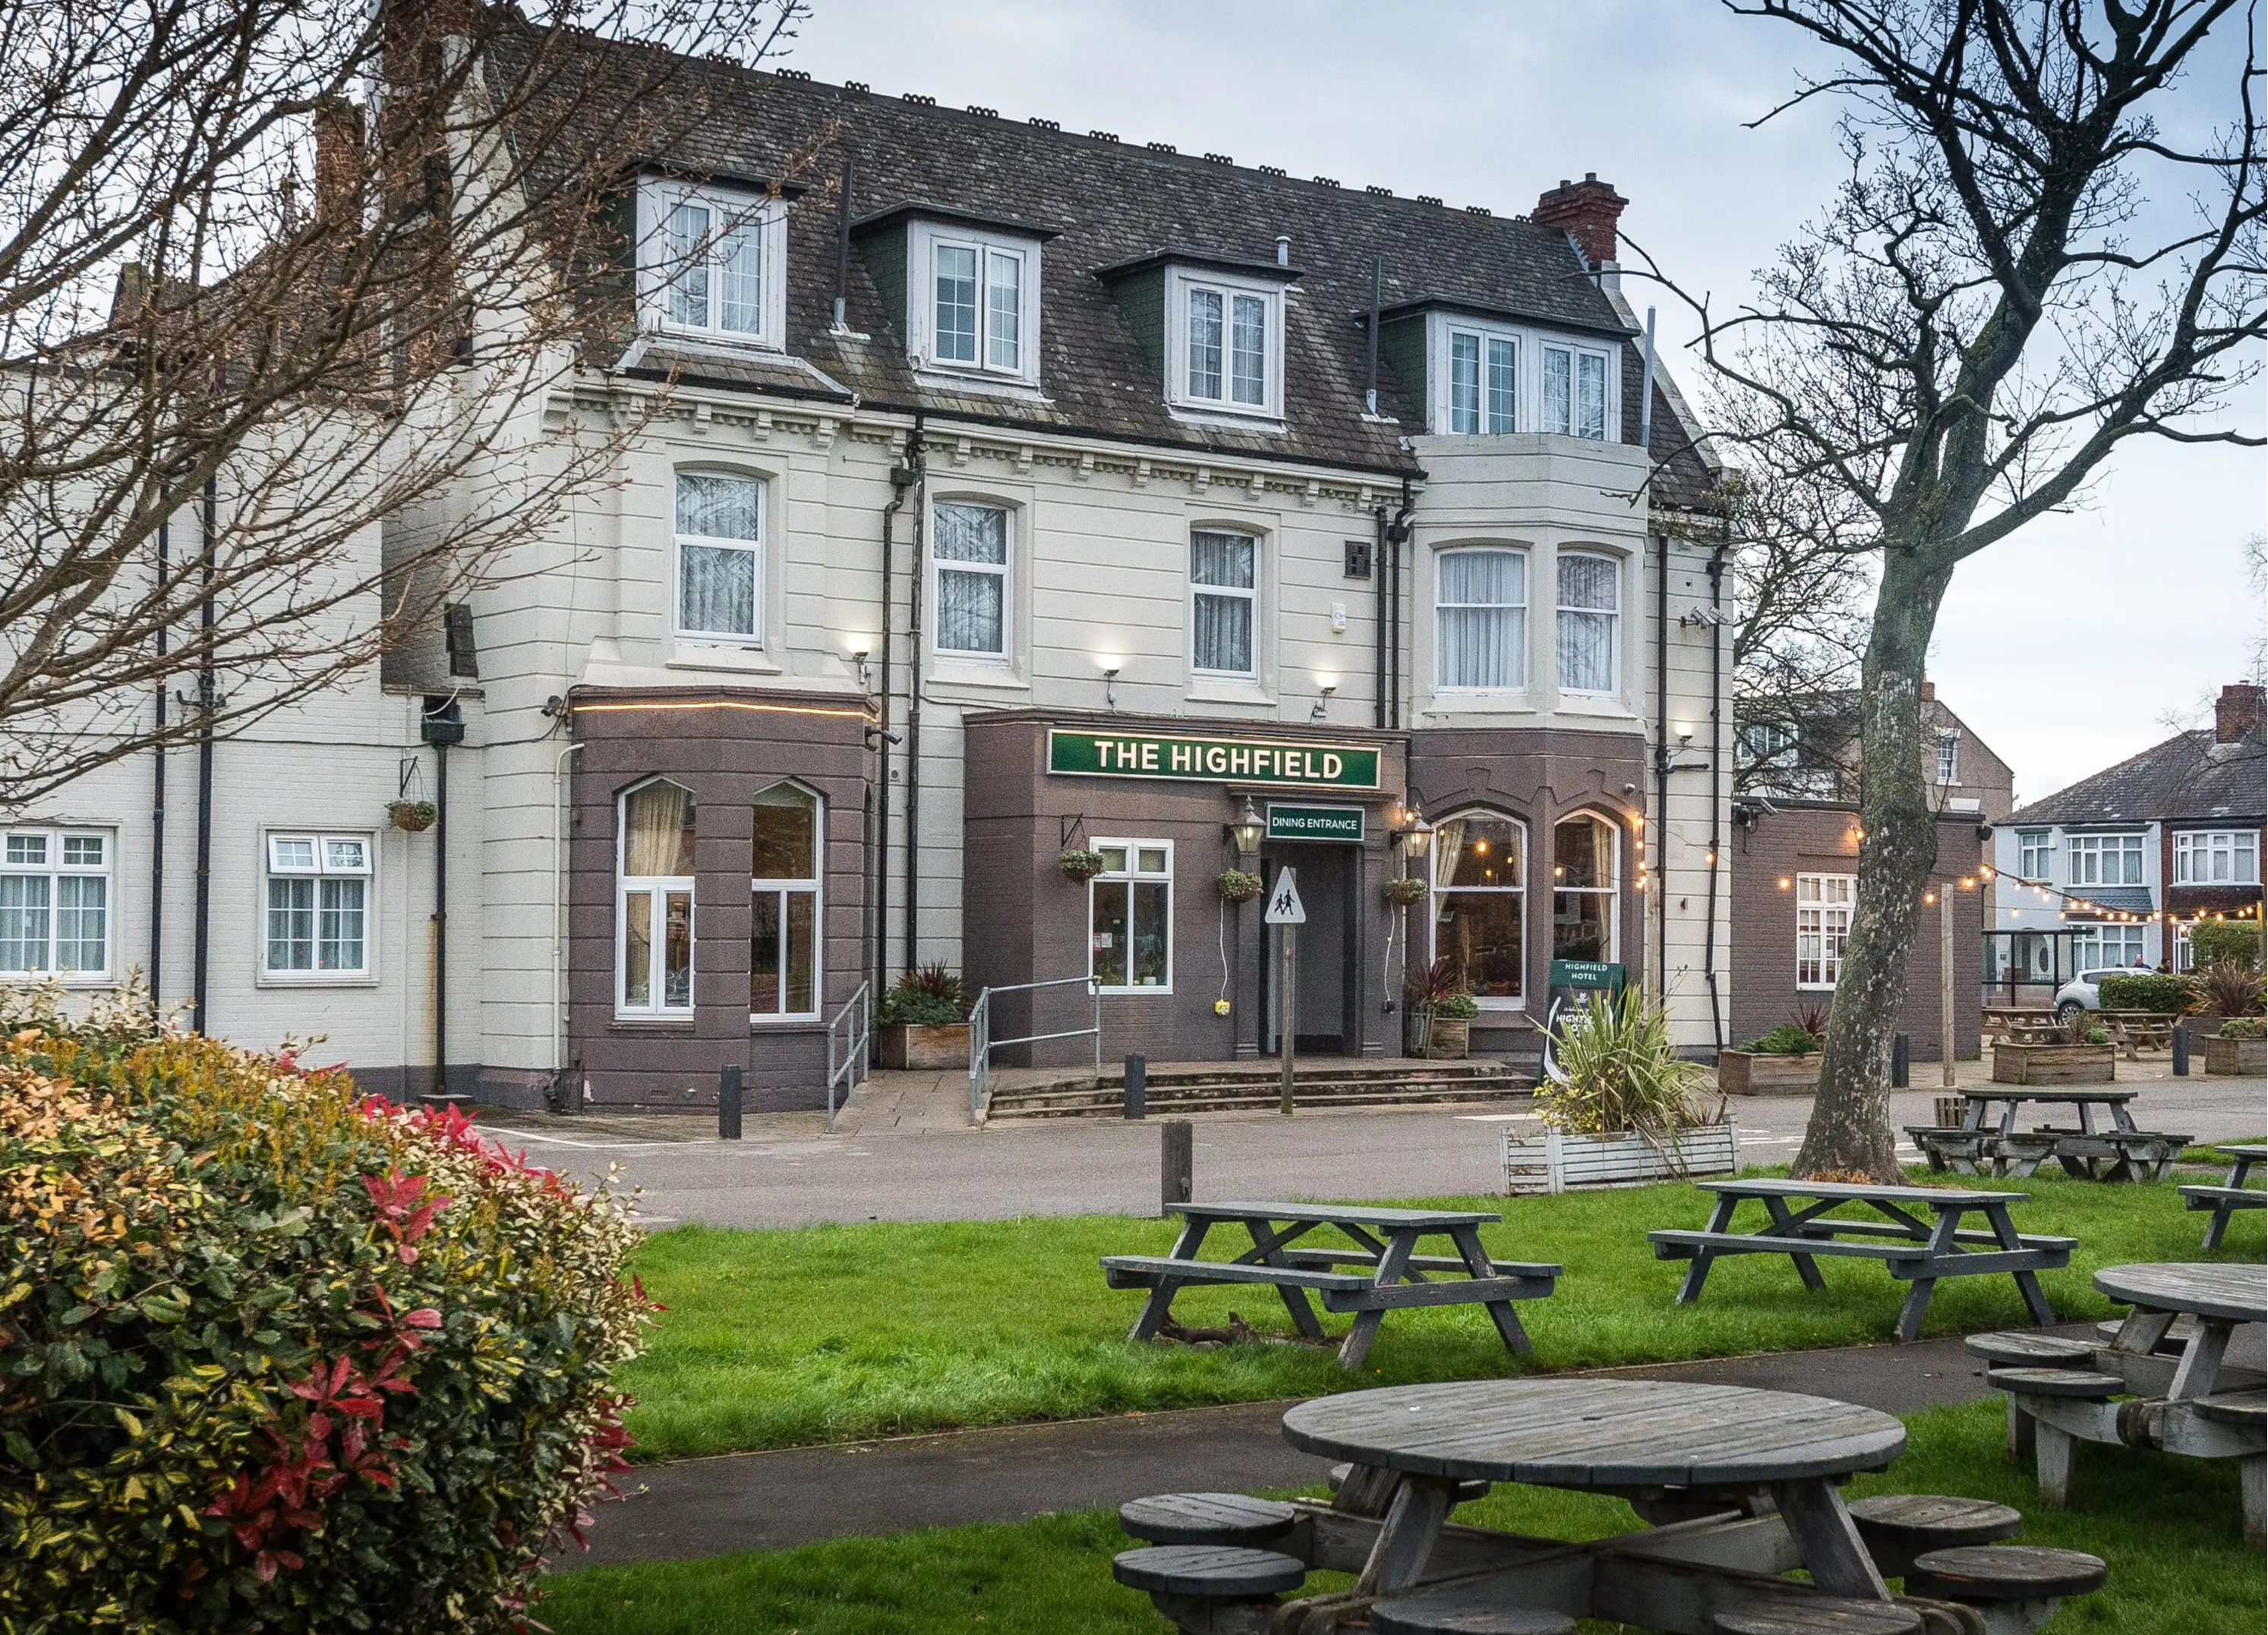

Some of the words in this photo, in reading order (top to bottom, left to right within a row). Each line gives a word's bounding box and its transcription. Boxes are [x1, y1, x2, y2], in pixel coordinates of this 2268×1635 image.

[1093, 740, 1159, 770] THE
[1170, 745, 1343, 779] HIGHFIELD
[1272, 816, 1305, 828] DINING
[1307, 818, 1358, 830] ENTRANCE
[1565, 963, 1608, 971] HIGHFIELD
[1571, 972, 1597, 980] HOTEL
